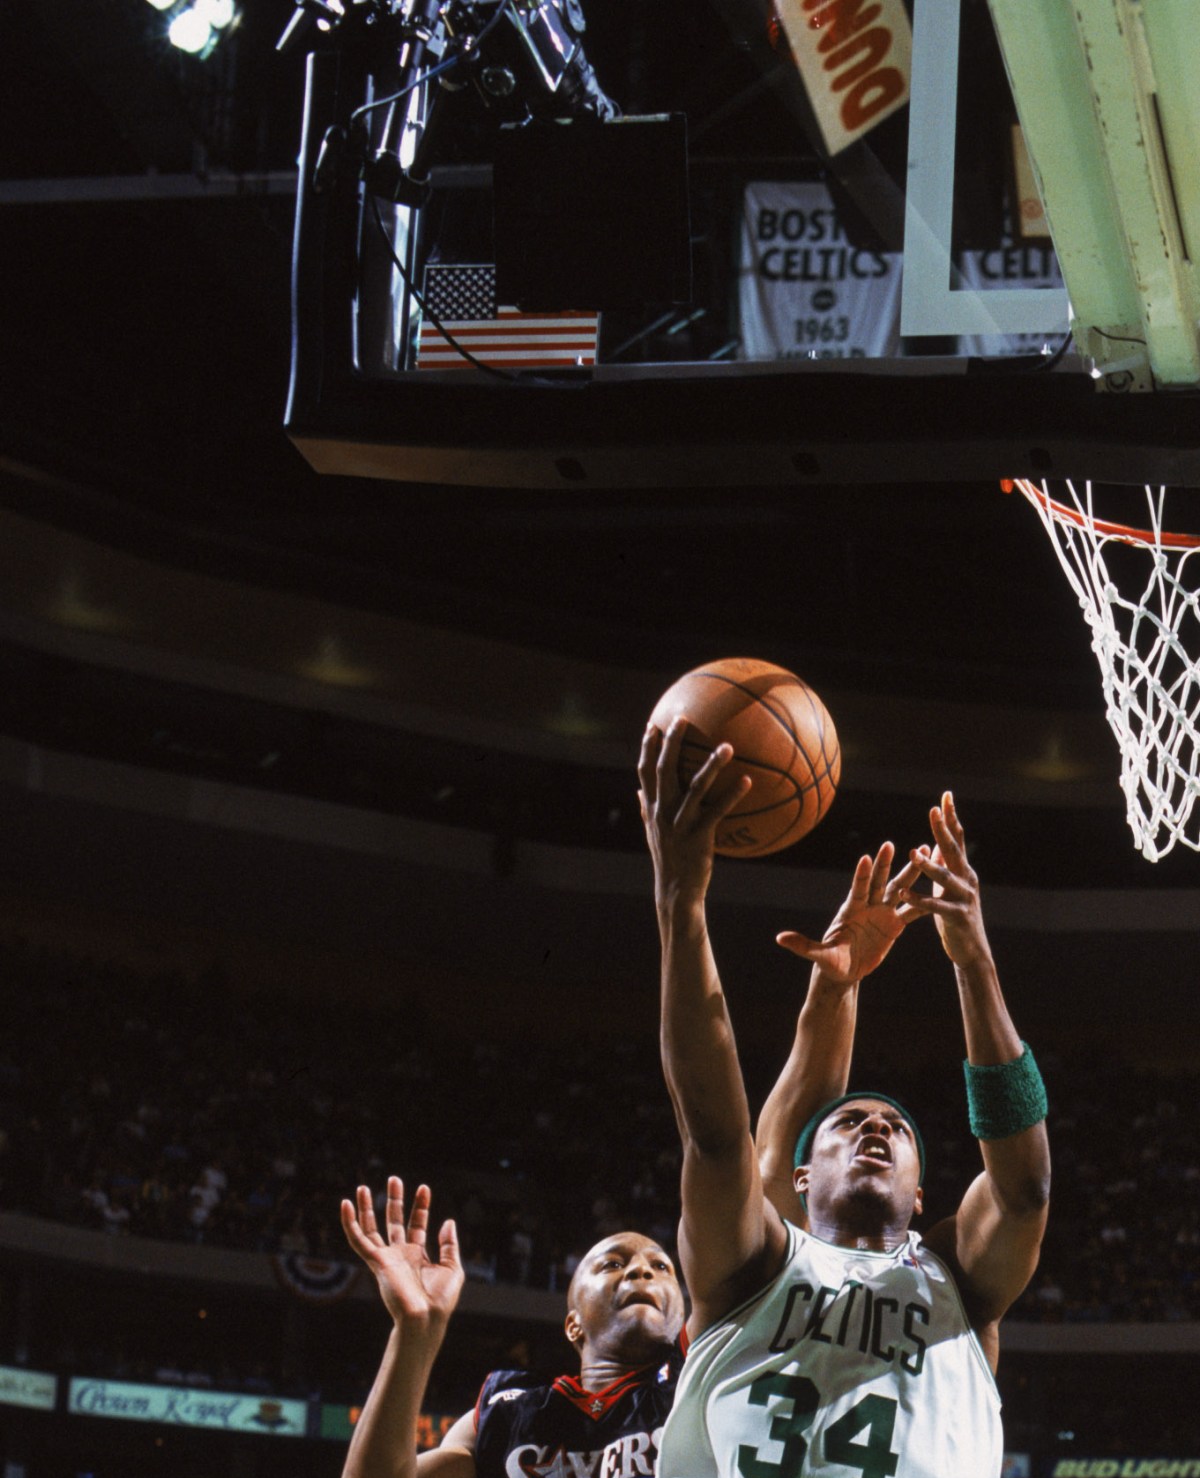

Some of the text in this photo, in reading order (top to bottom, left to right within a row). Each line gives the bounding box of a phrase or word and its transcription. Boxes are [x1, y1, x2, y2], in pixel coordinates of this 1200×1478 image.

[803, 0, 904, 131] DUN
[758, 208, 843, 242] BOST
[759, 247, 889, 281] CELTICS
[981, 248, 1052, 280] CELT
[794, 318, 849, 343] 1963
[76, 1383, 150, 1416] Crown
[150, 1389, 241, 1427] Royal
